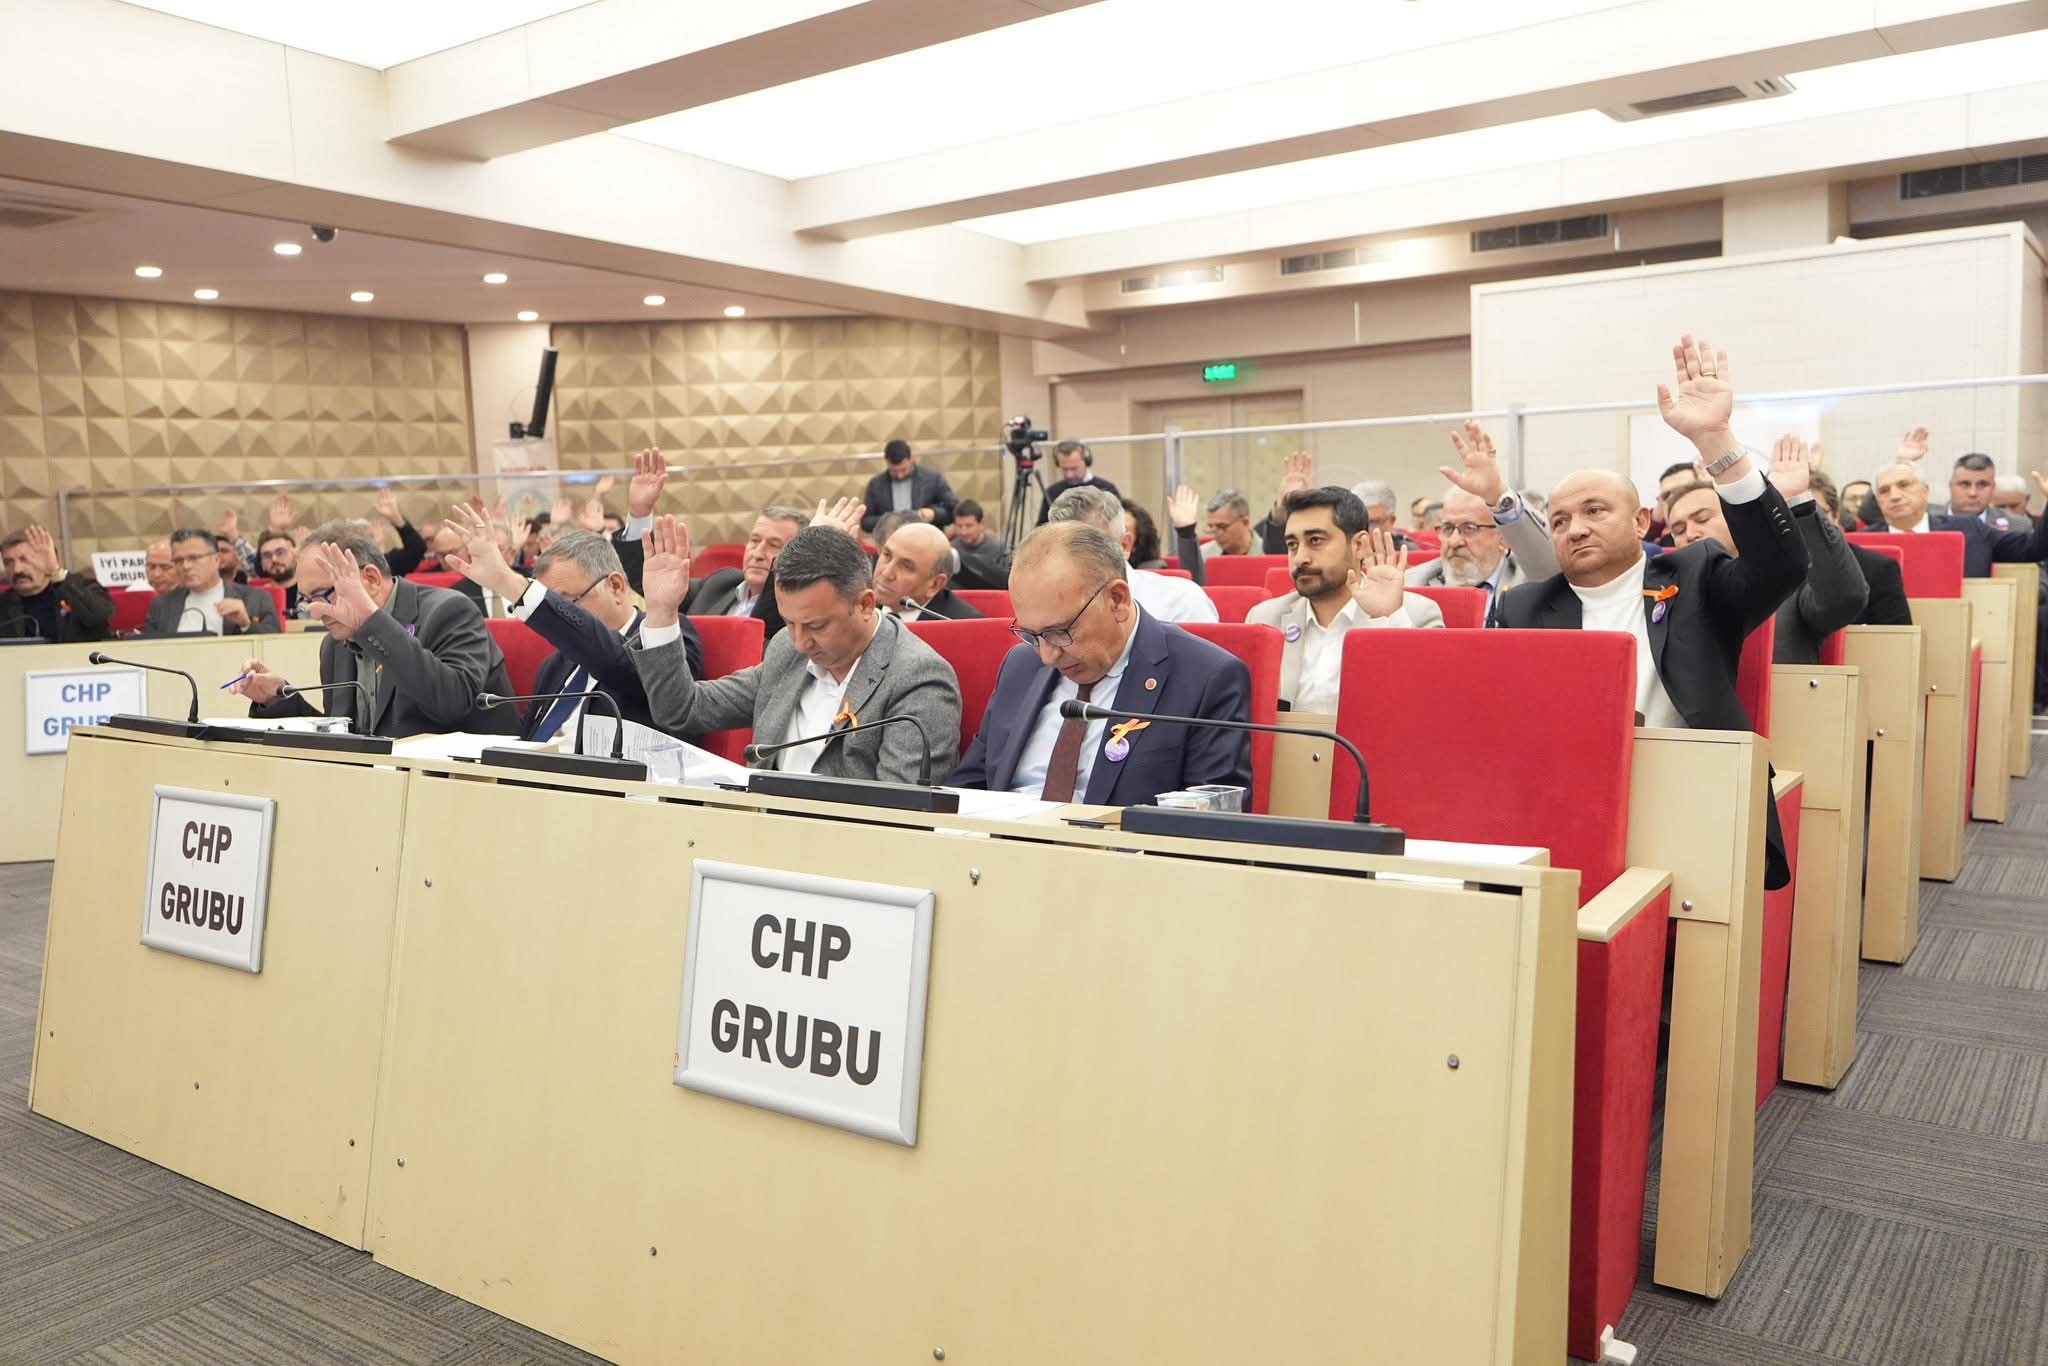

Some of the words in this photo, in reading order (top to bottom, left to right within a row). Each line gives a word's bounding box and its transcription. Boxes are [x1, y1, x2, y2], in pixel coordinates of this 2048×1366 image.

[121, 557, 145, 567] PAR
[61, 683, 112, 703] CHP
[182, 820, 232, 864] CHP
[160, 881, 245, 935] GRUBU
[751, 913, 851, 980] CHP
[711, 998, 881, 1086] GRUBU
